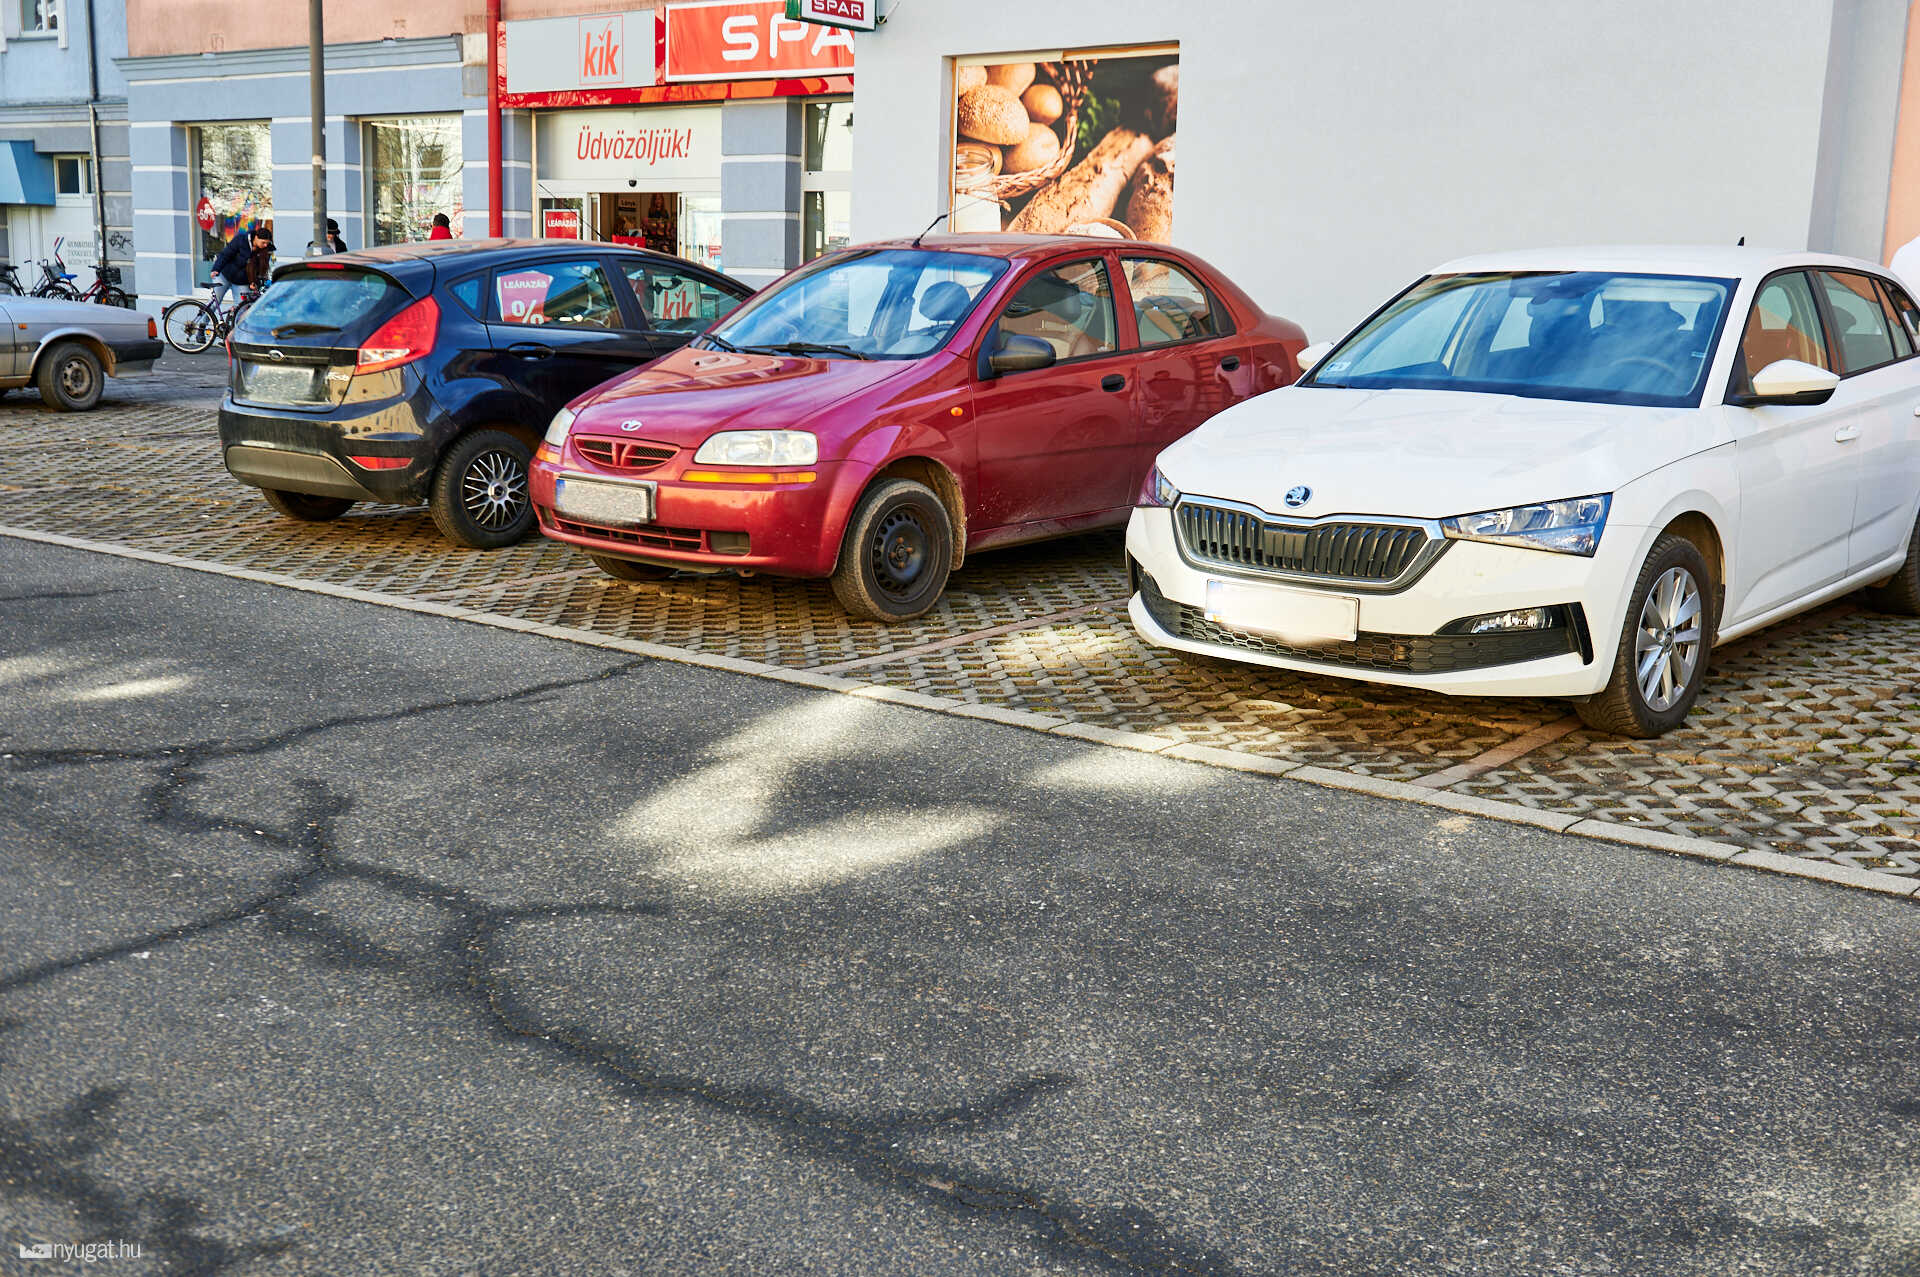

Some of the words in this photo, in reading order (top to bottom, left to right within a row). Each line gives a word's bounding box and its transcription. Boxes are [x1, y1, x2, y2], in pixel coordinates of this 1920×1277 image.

[813, 0, 862, 18] SPAR
[583, 21, 619, 77] kik
[577, 125, 691, 165] Üdvözöljük!
[547, 217, 577, 228] LEÁRAZÁS
[503, 277, 548, 290] LEÁRAZÁS
